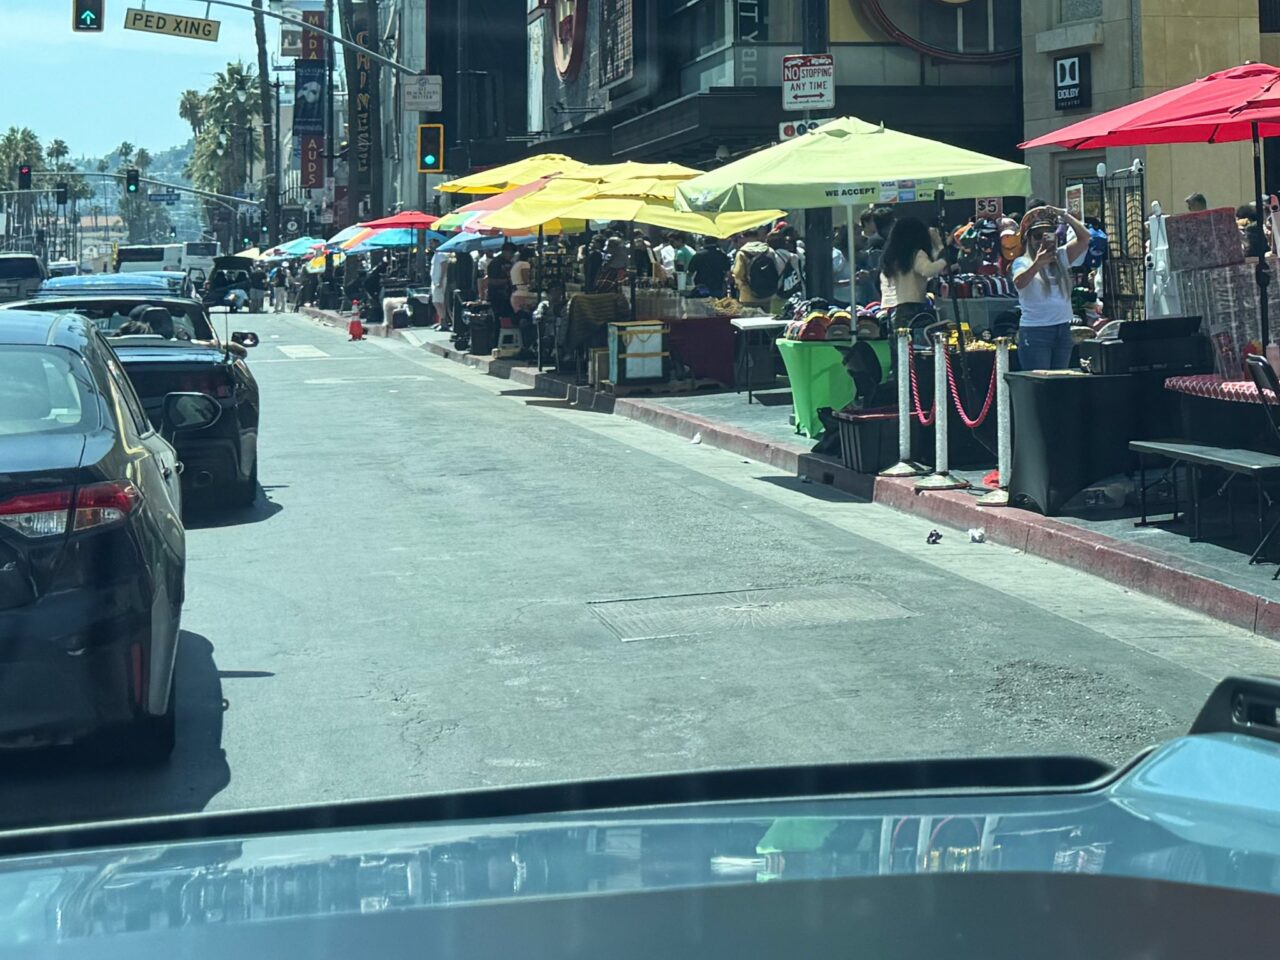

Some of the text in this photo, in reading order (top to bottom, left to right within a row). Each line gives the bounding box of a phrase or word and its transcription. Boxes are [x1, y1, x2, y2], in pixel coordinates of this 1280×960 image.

[132, 13, 212, 37] PED XING
[784, 67, 832, 80] NO STOPPING
[791, 81, 828, 91] ANY TIME
[1058, 88, 1079, 99] DOLBY
[842, 187, 876, 196] ACCEPT
[977, 200, 998, 215] $5
